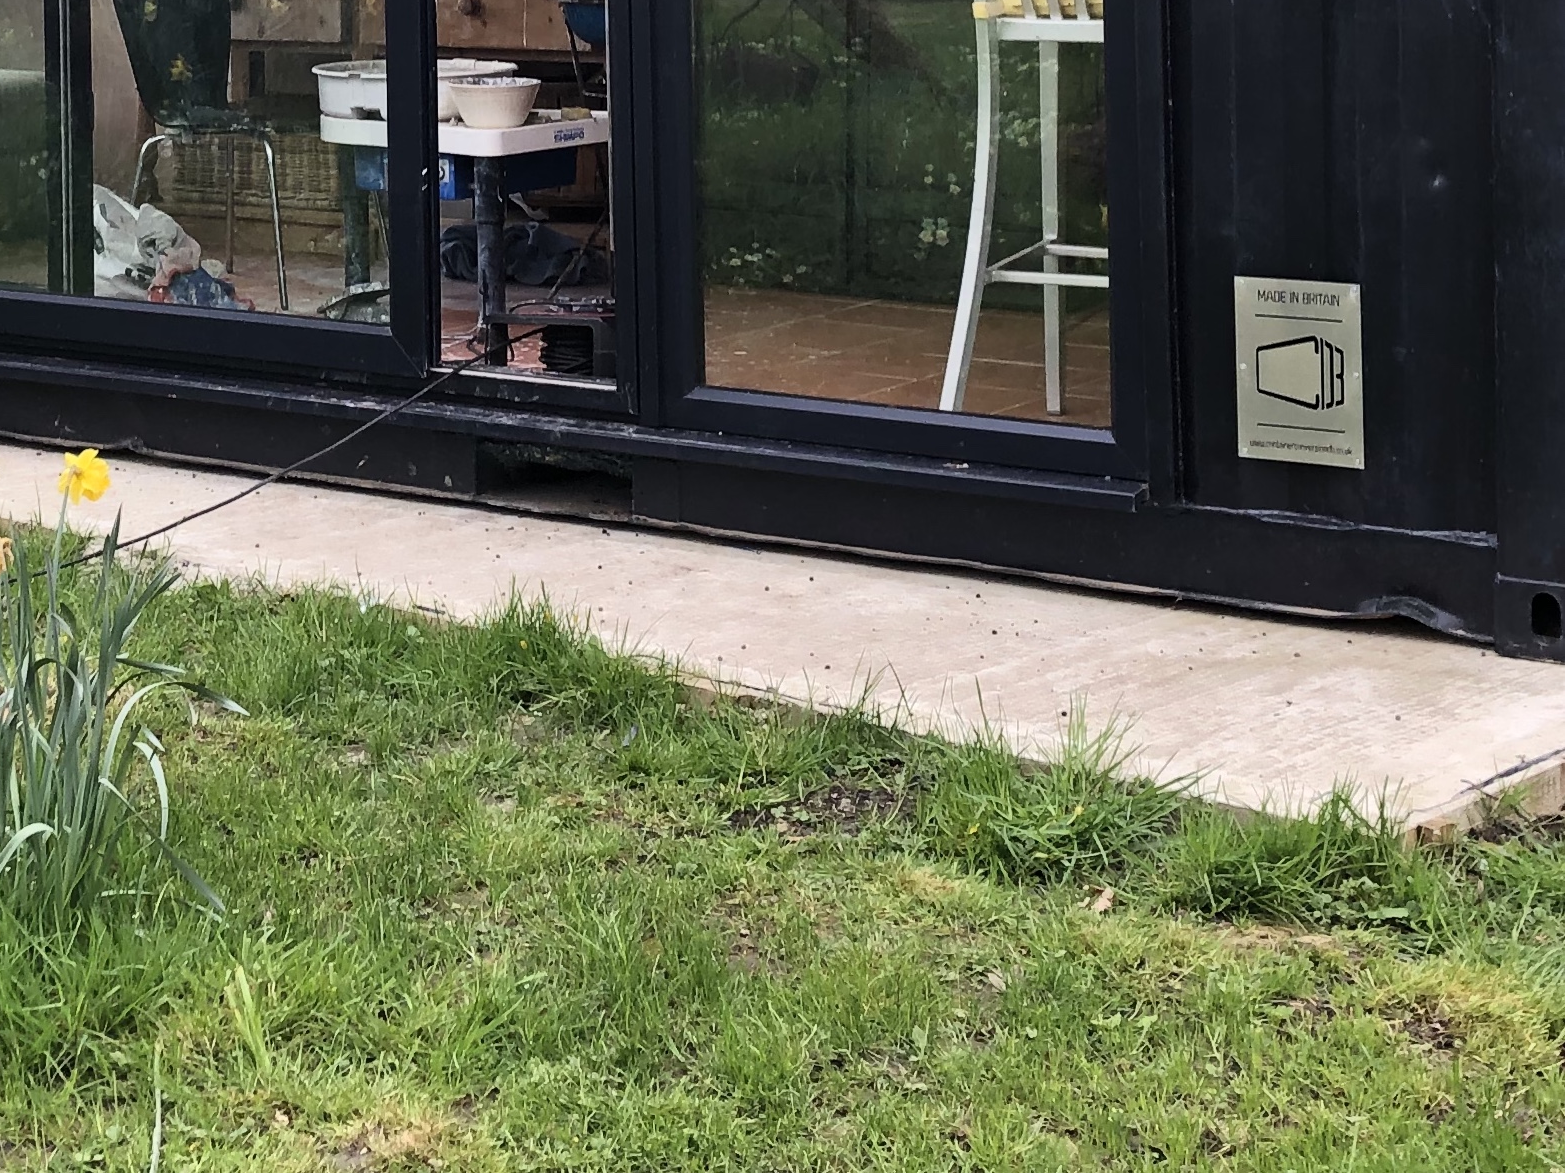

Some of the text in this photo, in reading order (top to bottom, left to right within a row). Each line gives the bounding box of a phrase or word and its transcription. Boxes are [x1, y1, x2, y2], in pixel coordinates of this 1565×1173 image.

[1257, 289, 1340, 307] MADE IN BRITAIN
